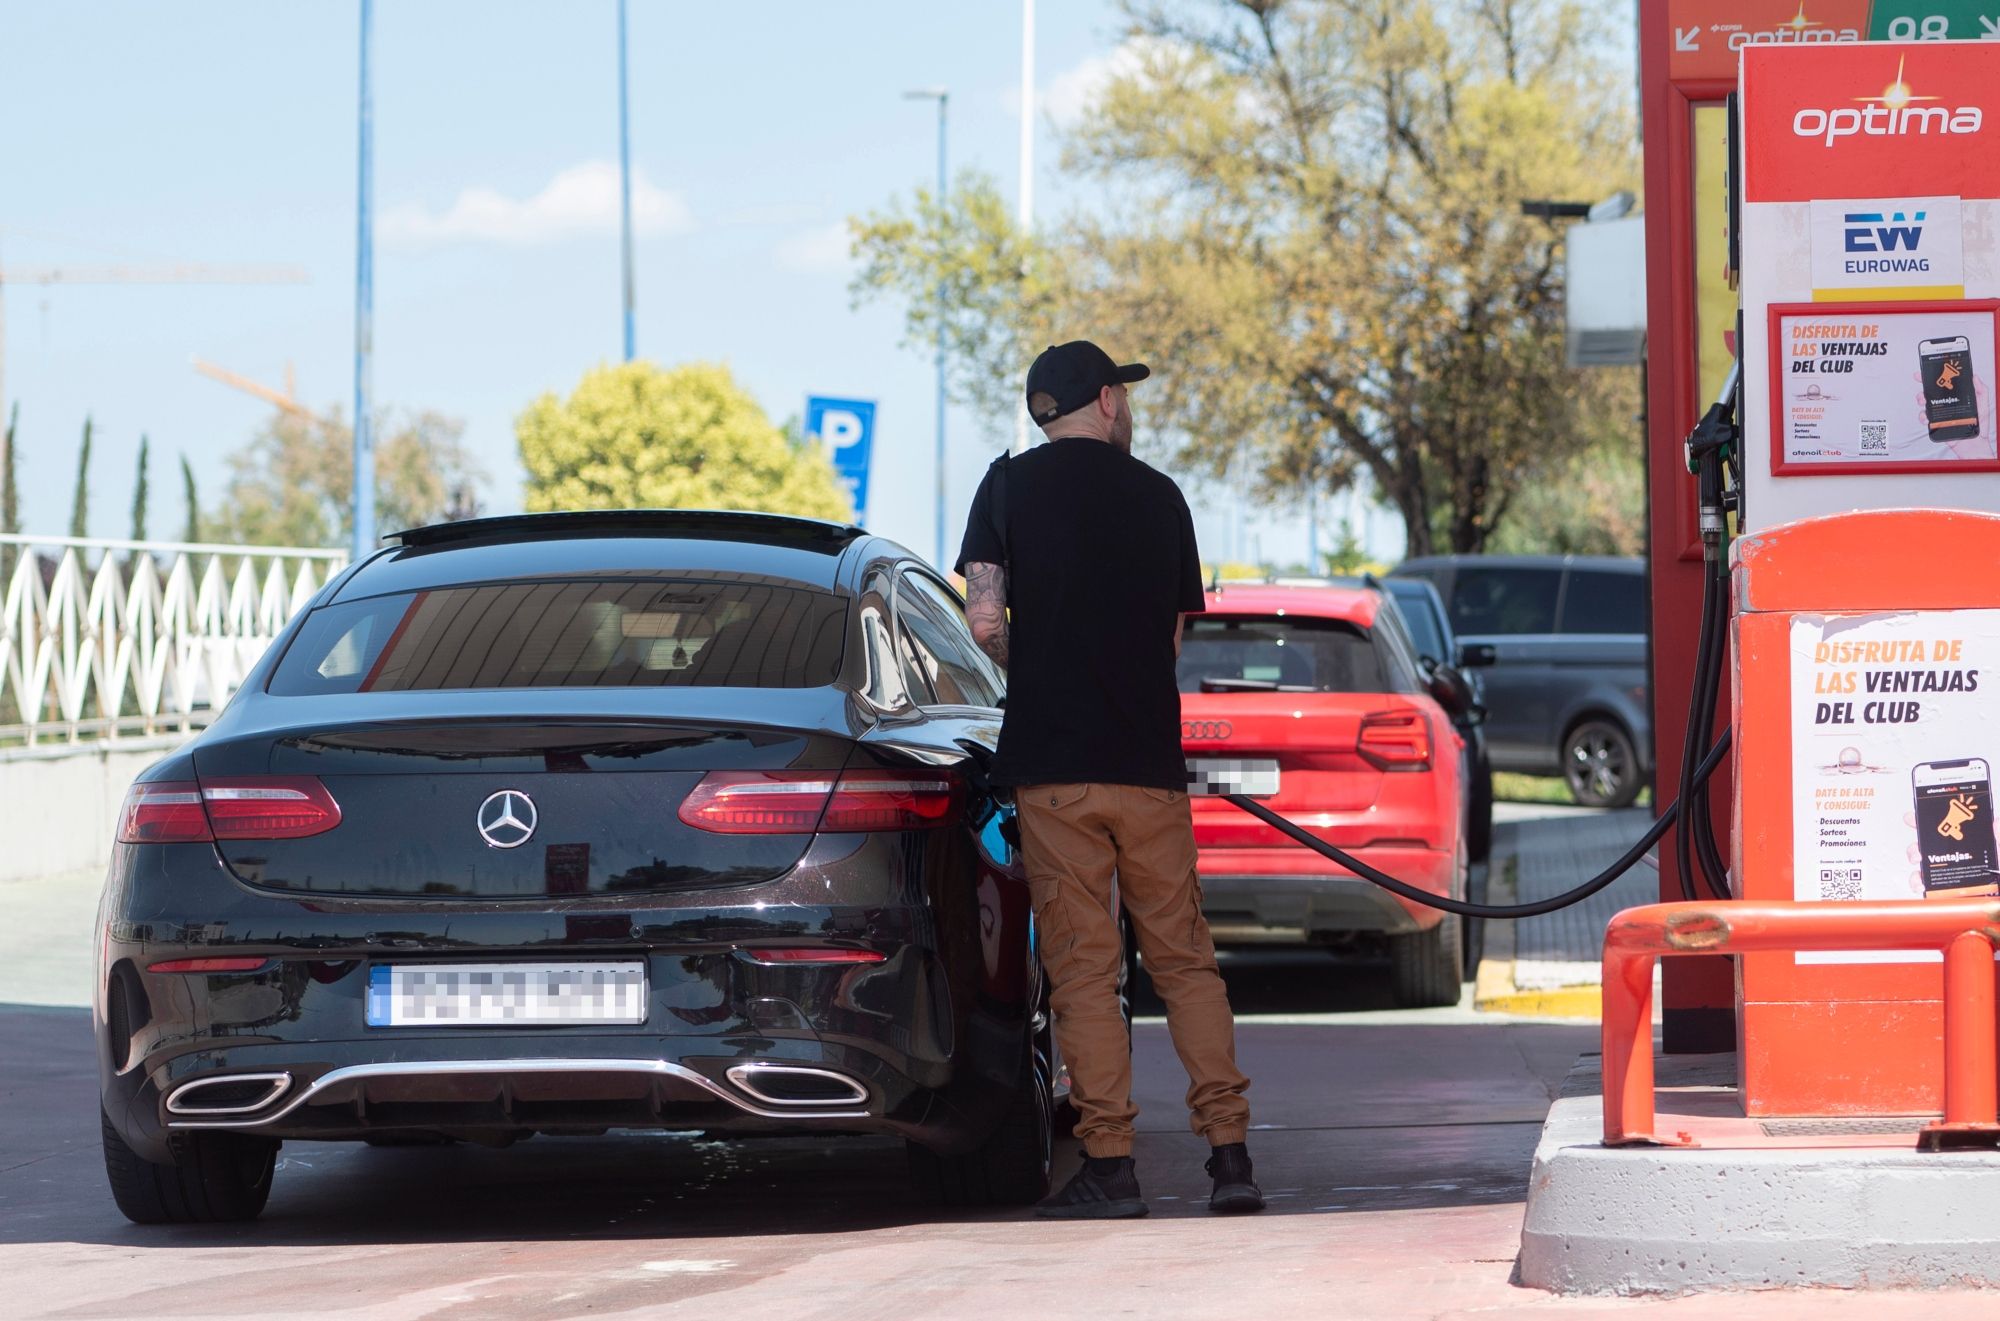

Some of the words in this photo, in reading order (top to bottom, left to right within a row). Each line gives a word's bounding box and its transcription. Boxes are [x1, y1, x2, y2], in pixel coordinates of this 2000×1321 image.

[1887, 15, 1949, 41] 98
[1792, 103, 1984, 148] optima
[1845, 258, 1930, 274] EUROWAG
[1792, 325, 1857, 339] DISFRUTA
[1860, 325, 1879, 338] DE
[1792, 343, 1817, 357] LAS
[1821, 342, 1888, 356] VENTAJAS
[1792, 360, 1816, 373] DEL
[1820, 360, 1854, 373] CLUB
[820, 408, 864, 464] P
[1814, 640, 1926, 664] DISFRUTA
[1932, 639, 1963, 662] DE
[1814, 671, 1857, 695] LAS
[1865, 670, 1979, 693] VENTAJAS
[1815, 702, 1855, 725] DEL
[1863, 701, 1921, 724] CLUB
[1815, 788, 1838, 798] DATE
[1840, 788, 1852, 797] DE
[1853, 787, 1875, 797] ALTA
[1816, 801, 1822, 811] Y
[1824, 801, 1871, 810] CONSIGUE:
[1820, 817, 1861, 825] Descuentos
[1820, 839, 1867, 847] Promociones
[1928, 851, 1973, 863] Ventajas.
